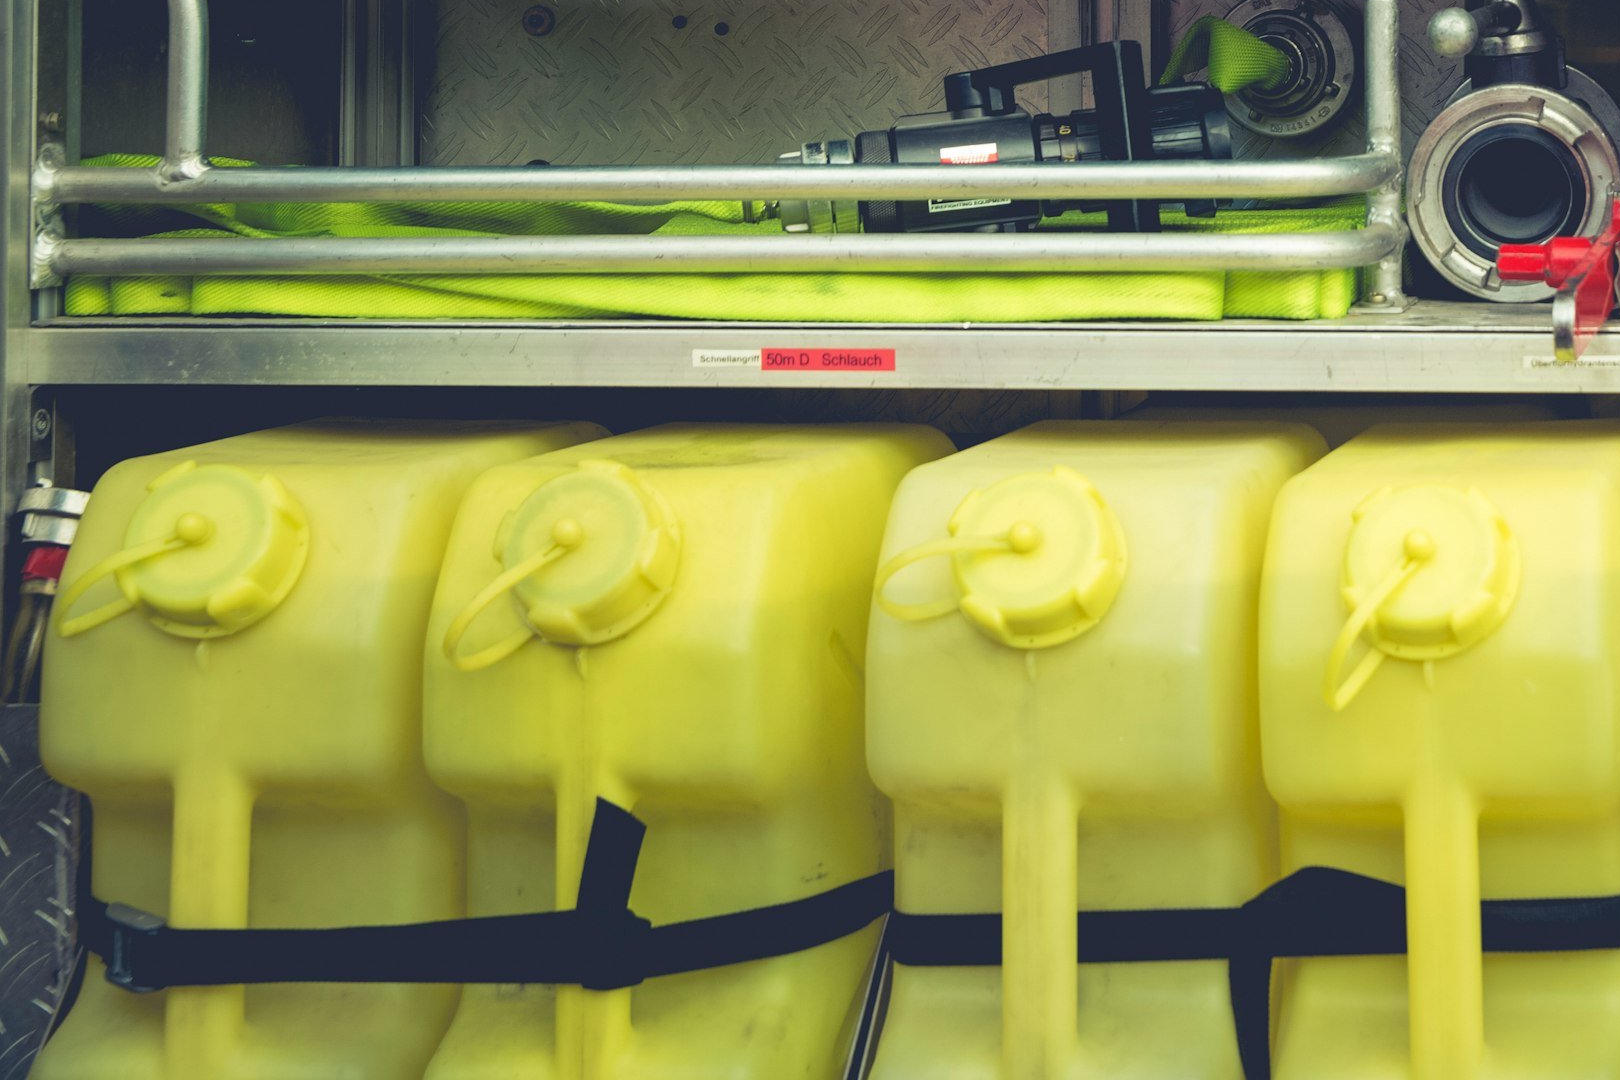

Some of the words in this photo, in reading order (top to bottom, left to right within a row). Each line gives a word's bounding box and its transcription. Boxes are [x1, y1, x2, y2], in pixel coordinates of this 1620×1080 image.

[700, 354, 760, 365] Schnellangriff
[766, 353, 795, 367] 50m
[799, 353, 810, 367] D
[822, 352, 882, 367] Schlauch
